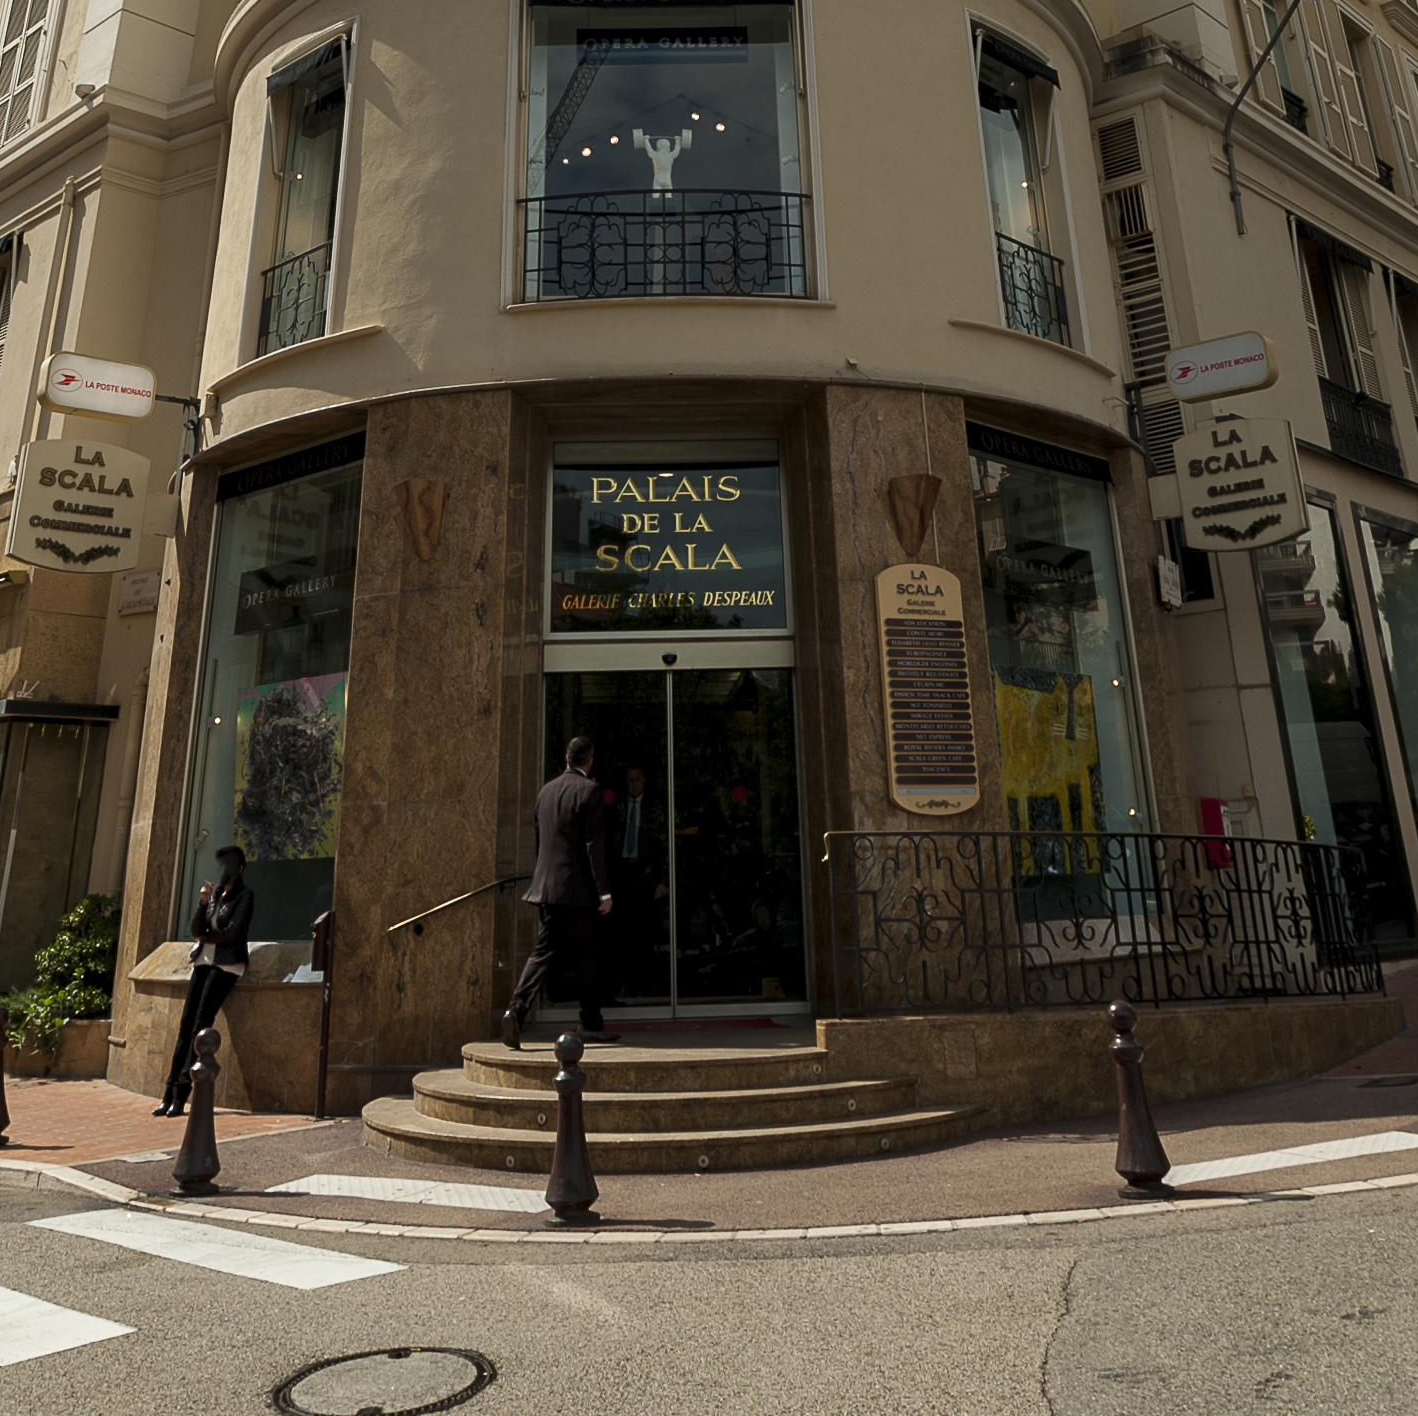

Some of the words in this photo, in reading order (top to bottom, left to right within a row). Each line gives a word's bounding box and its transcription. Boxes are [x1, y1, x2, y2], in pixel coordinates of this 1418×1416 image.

[583, 37, 649, 52] OPERA
[658, 36, 745, 49] GALLERY
[1200, 362, 1210, 373] LA
[1210, 359, 1233, 372] POSTE
[1233, 352, 1265, 367] MONACO
[84, 380, 95, 389] LA
[96, 382, 120, 394] POSTE
[120, 386, 152, 398] MONACO
[1211, 428, 1242, 448] LA
[74, 445, 106, 467] LA
[981, 430, 1030, 459] OPERA
[1033, 445, 1092, 474] GALLERY
[1188, 444, 1279, 478] SCALA
[237, 464, 282, 492] OPERA
[287, 442, 351, 475] GALLERY
[38, 466, 134, 498] SCALA
[590, 475, 741, 503] PALAIS
[1207, 477, 1265, 498] GALERIE
[53, 499, 114, 518] GALERIE
[1191, 493, 1287, 519] COMMERCIALE
[29, 514, 132, 538] COMMERCIALE
[621, 512, 660, 534] DE
[673, 512, 714, 533] LA
[595, 542, 743, 572] SCALA
[995, 554, 1036, 575] OPERA
[910, 570, 927, 580] LA
[242, 588, 279, 610] OPERA
[285, 574, 337, 597] GALLERY
[562, 593, 620, 610] GALERIE
[628, 591, 696, 608] CHARLES
[703, 590, 775, 607] DESPEAUX
[896, 583, 944, 596] SCALA
[898, 607, 946, 616] COMMERCIALE
[907, 599, 935, 607] GALERIE
